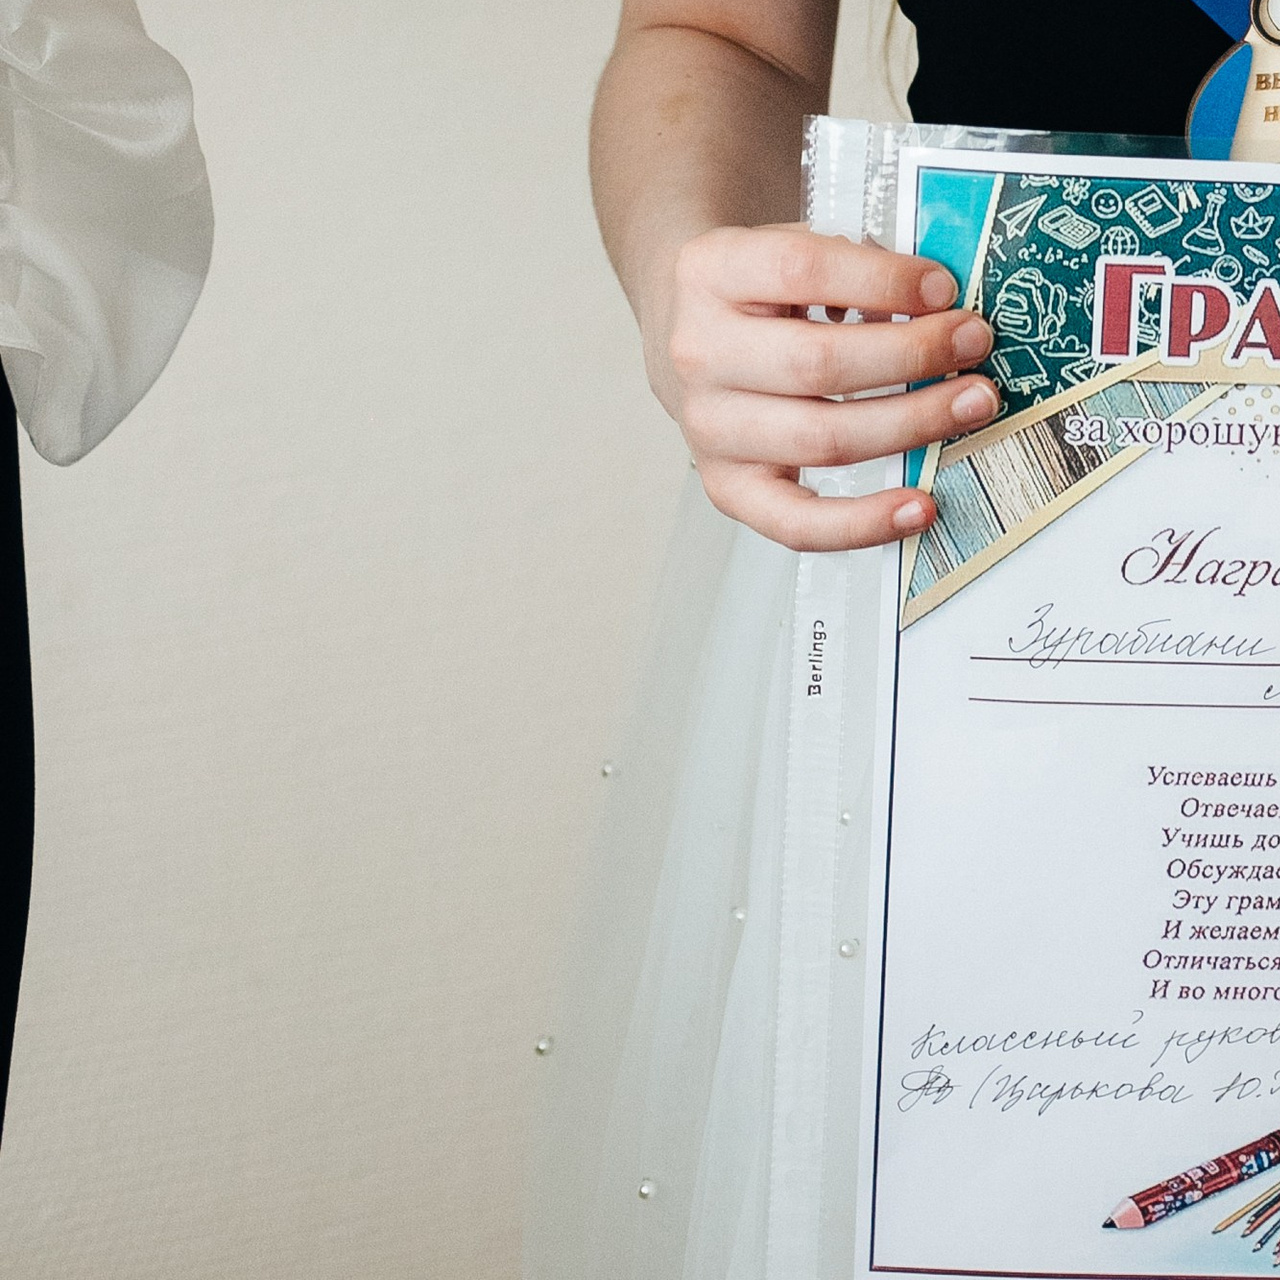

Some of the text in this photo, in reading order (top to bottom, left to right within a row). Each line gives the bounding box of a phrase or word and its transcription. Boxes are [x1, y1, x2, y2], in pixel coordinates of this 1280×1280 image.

[1064, 418, 1107, 443] за
[807, 619, 827, 697] Berlingo
[1147, 765, 1278, 788] Успеваешь
[1161, 827, 1244, 849] Учишь
[1171, 889, 1219, 916] Эту
[1160, 919, 1184, 941] И
[1188, 924, 1280, 941] желаем
[1148, 978, 1172, 1000] И
[1177, 985, 1206, 1001] во
[910, 1009, 1144, 1059] Классный
